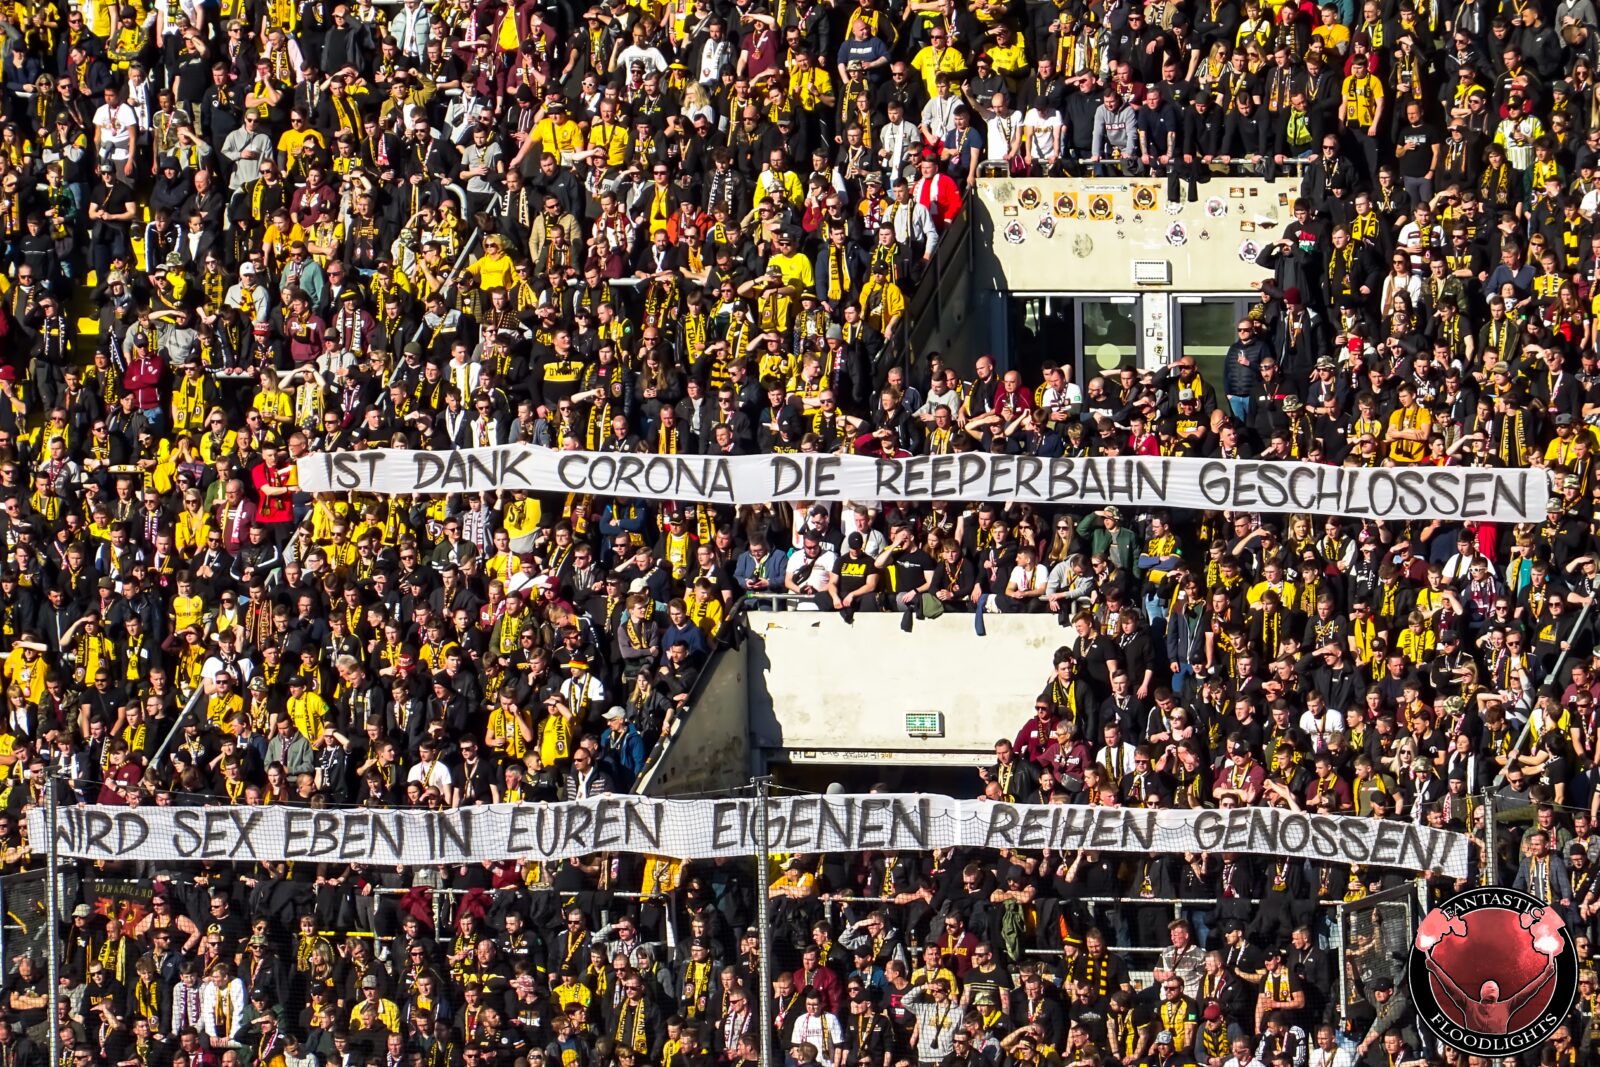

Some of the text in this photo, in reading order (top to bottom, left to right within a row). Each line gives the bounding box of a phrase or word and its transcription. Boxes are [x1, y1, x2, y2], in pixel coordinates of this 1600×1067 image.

[324, 450, 1527, 519] IST DANK CORONA DIE REEPERBAHN GESCHLOSSEN
[55, 798, 1457, 877] WIRD SEX EBEN IN EUREN EIGENEN REIHEN GENOSSEN!
